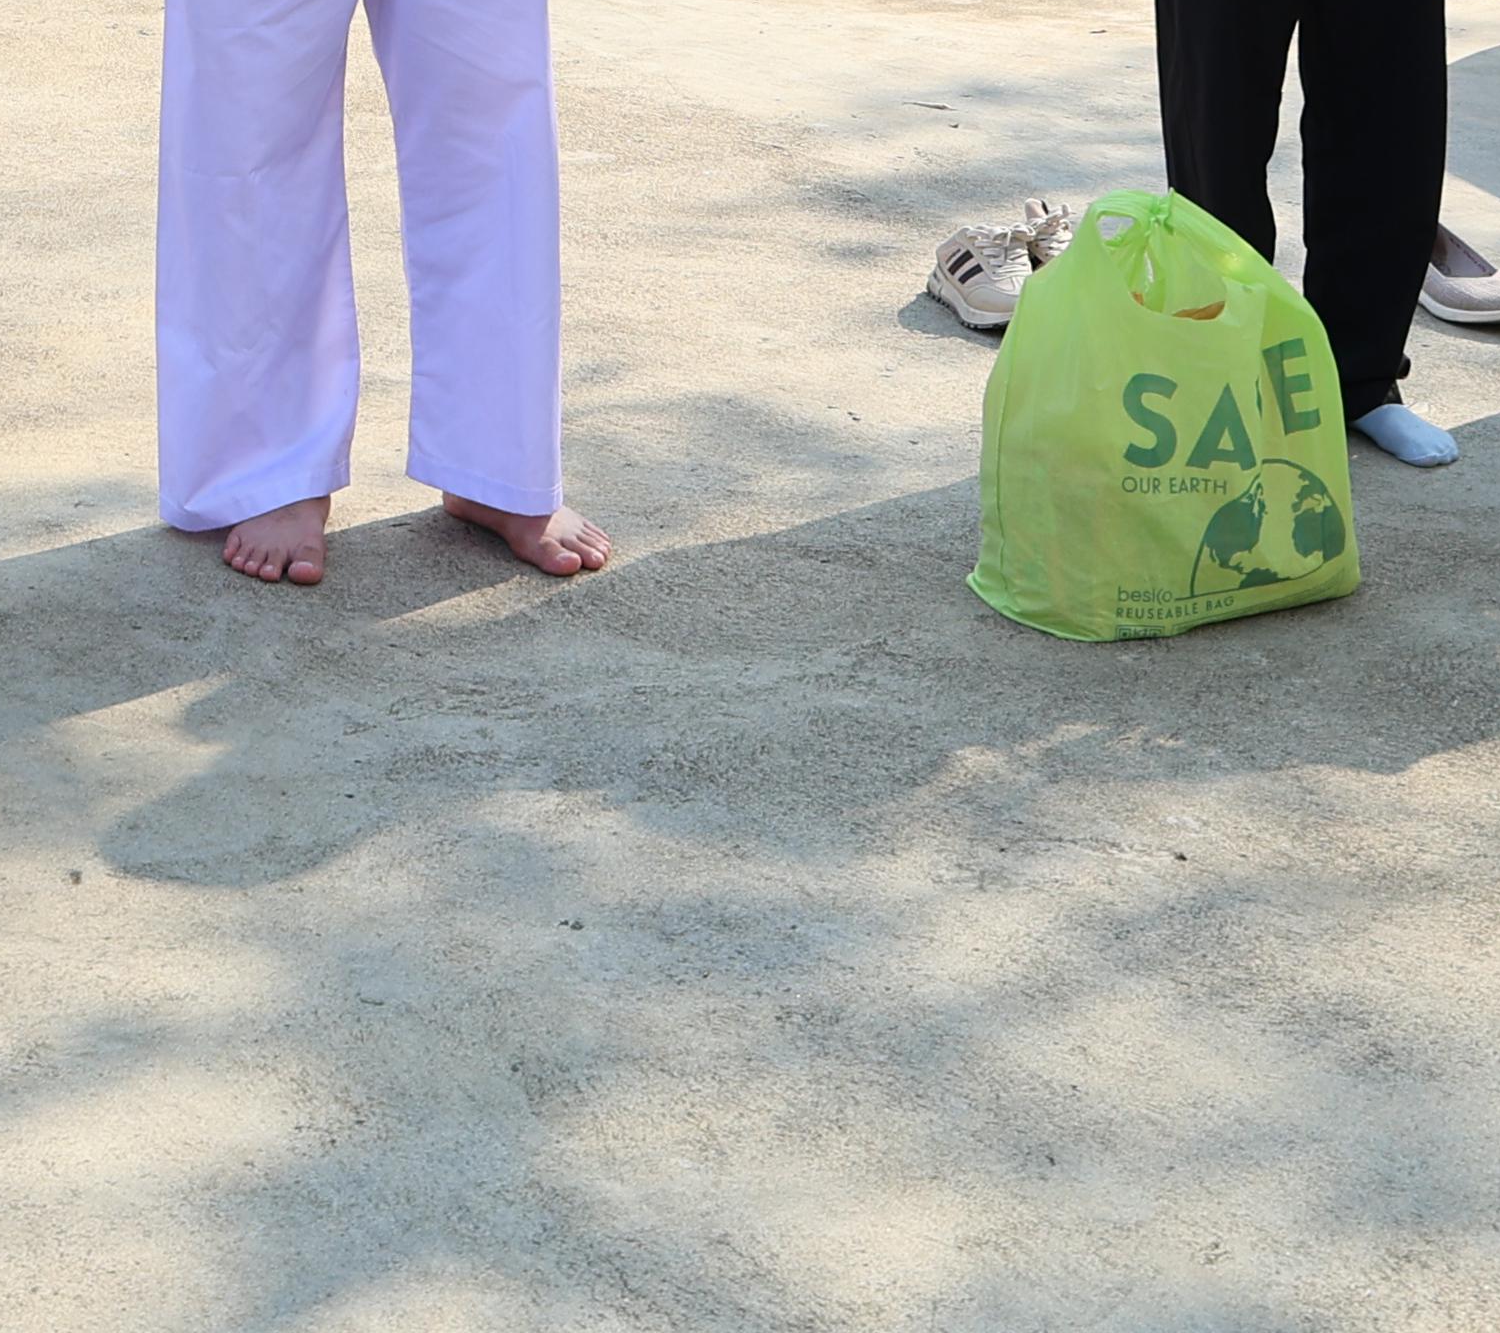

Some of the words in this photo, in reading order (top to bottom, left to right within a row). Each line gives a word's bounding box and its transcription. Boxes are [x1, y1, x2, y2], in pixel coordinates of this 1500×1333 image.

[1122, 337, 1322, 471] SAE
[1121, 475, 1162, 495] OUR
[1169, 476, 1228, 496] EARTH
[1115, 602, 1199, 620] REUSEABLE
[1206, 596, 1236, 612] BAG
